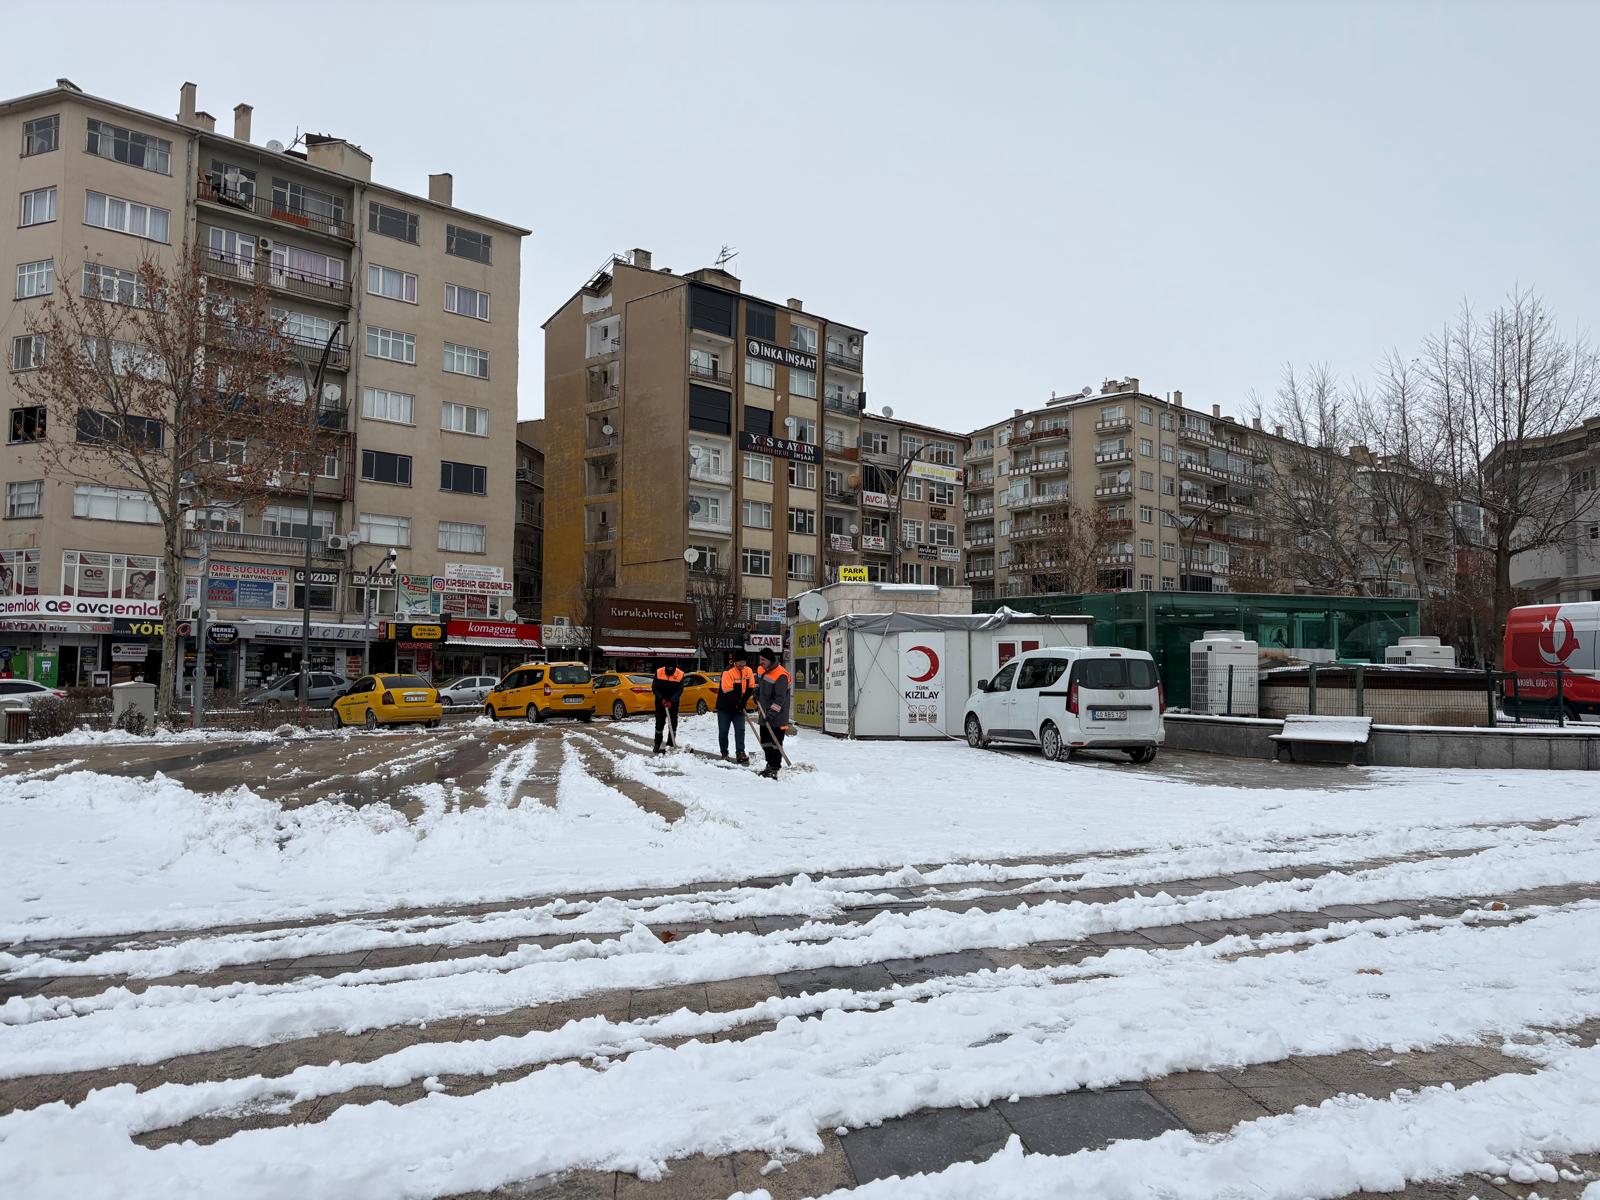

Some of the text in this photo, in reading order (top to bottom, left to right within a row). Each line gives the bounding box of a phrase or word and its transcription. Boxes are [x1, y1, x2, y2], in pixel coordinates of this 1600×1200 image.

[760, 343, 816, 369] İNKA İNŞAAT
[352, 576, 394, 586] EMLAK
[46, 600, 166, 616] ae avcıemla
[610, 608, 684, 620] Kurukahveciler
[468, 622, 516, 636] komagene
[746, 636, 781, 647] CZANE
[905, 691, 939, 700] KIZILAY
